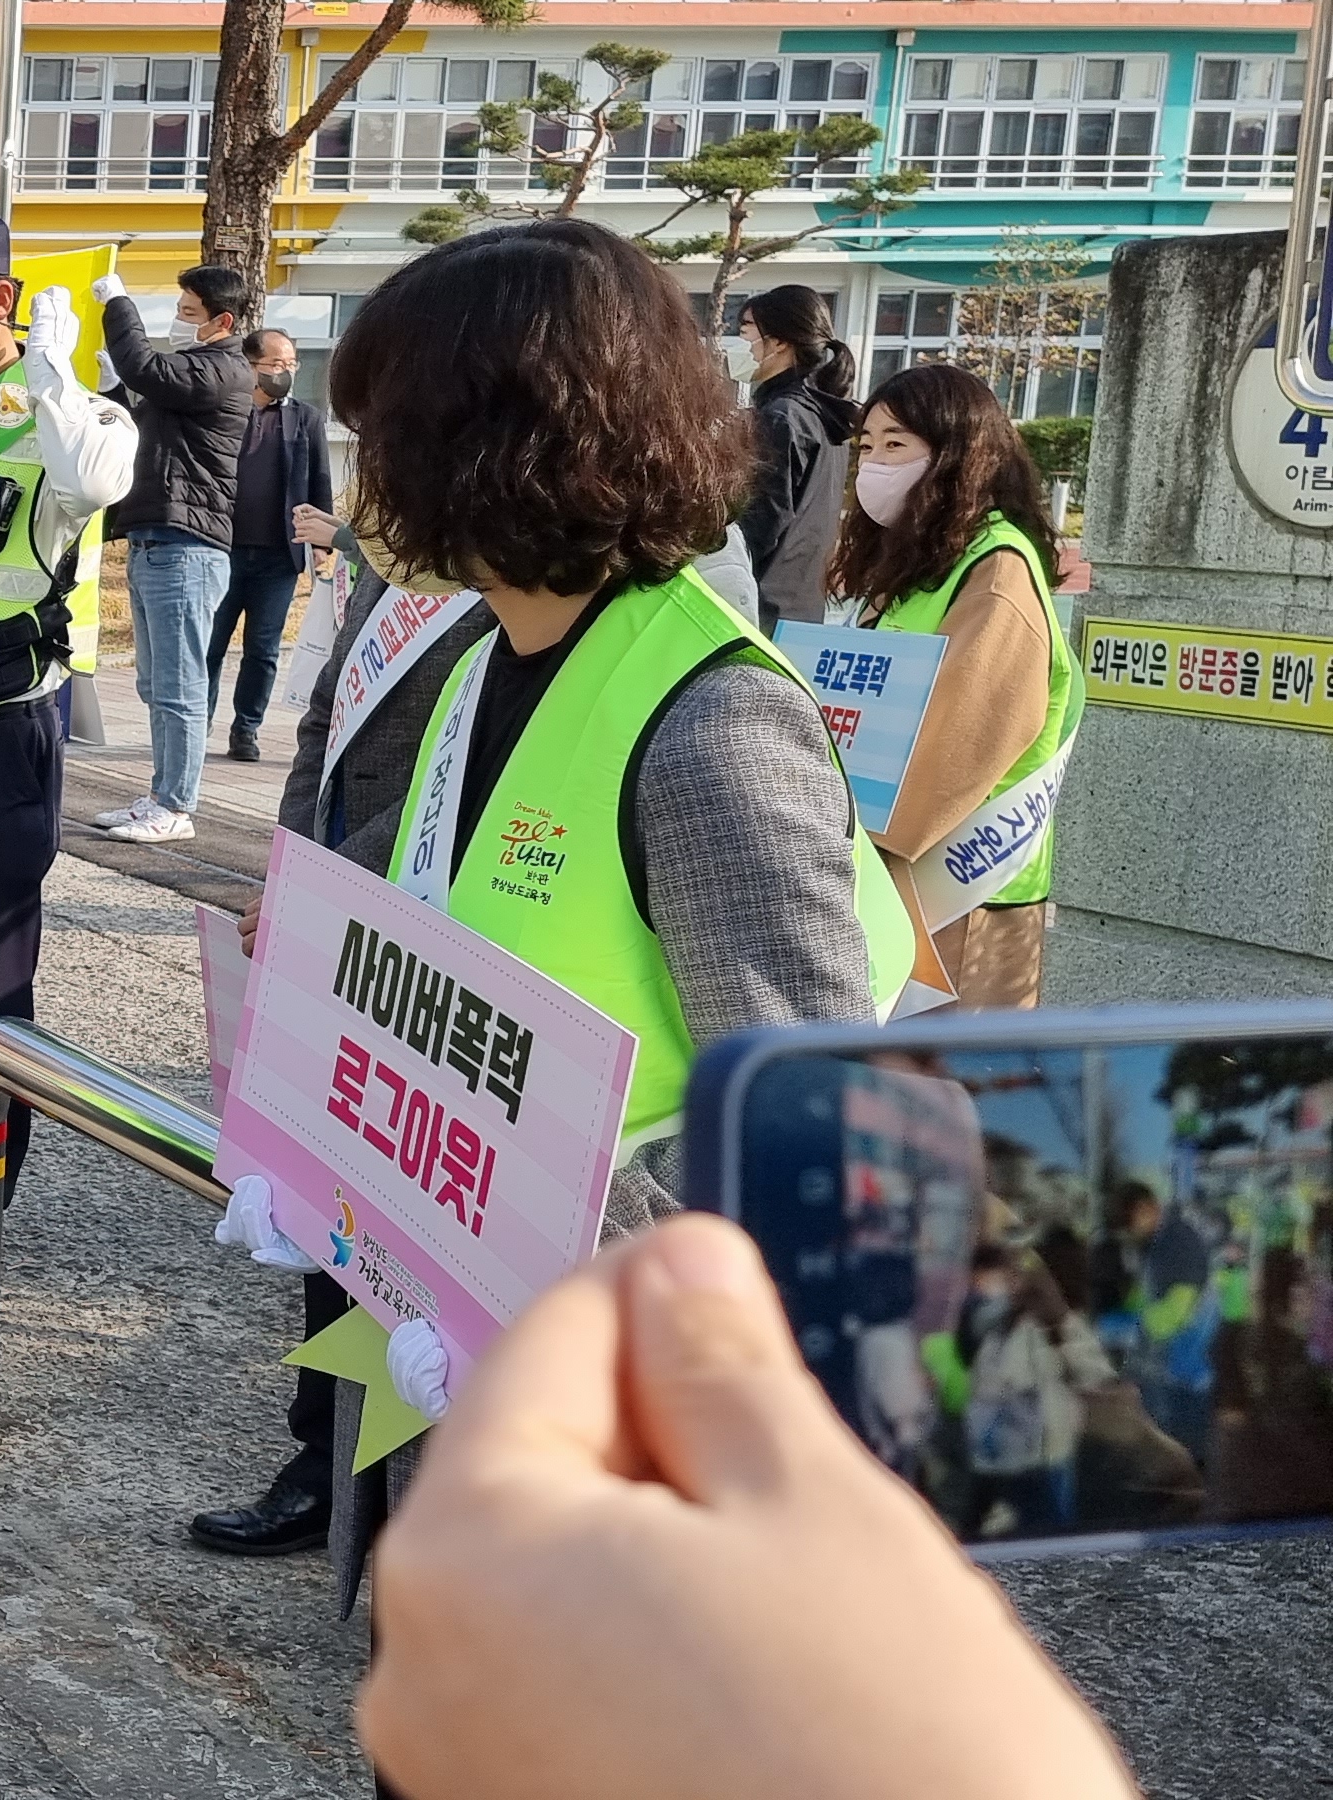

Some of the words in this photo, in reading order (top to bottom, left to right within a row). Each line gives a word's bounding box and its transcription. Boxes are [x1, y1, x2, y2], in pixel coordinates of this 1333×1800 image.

[813, 649, 892, 697] 학교폭력
[1090, 639, 1167, 686] 외부인은
[1179, 646, 1260, 697] 방문증을
[1272, 656, 1314, 704] 받아
[333, 918, 533, 1125] 사이버폭력
[327, 1034, 496, 1238] 로그아웃!
[358, 1256, 436, 1333] 거창교육지
